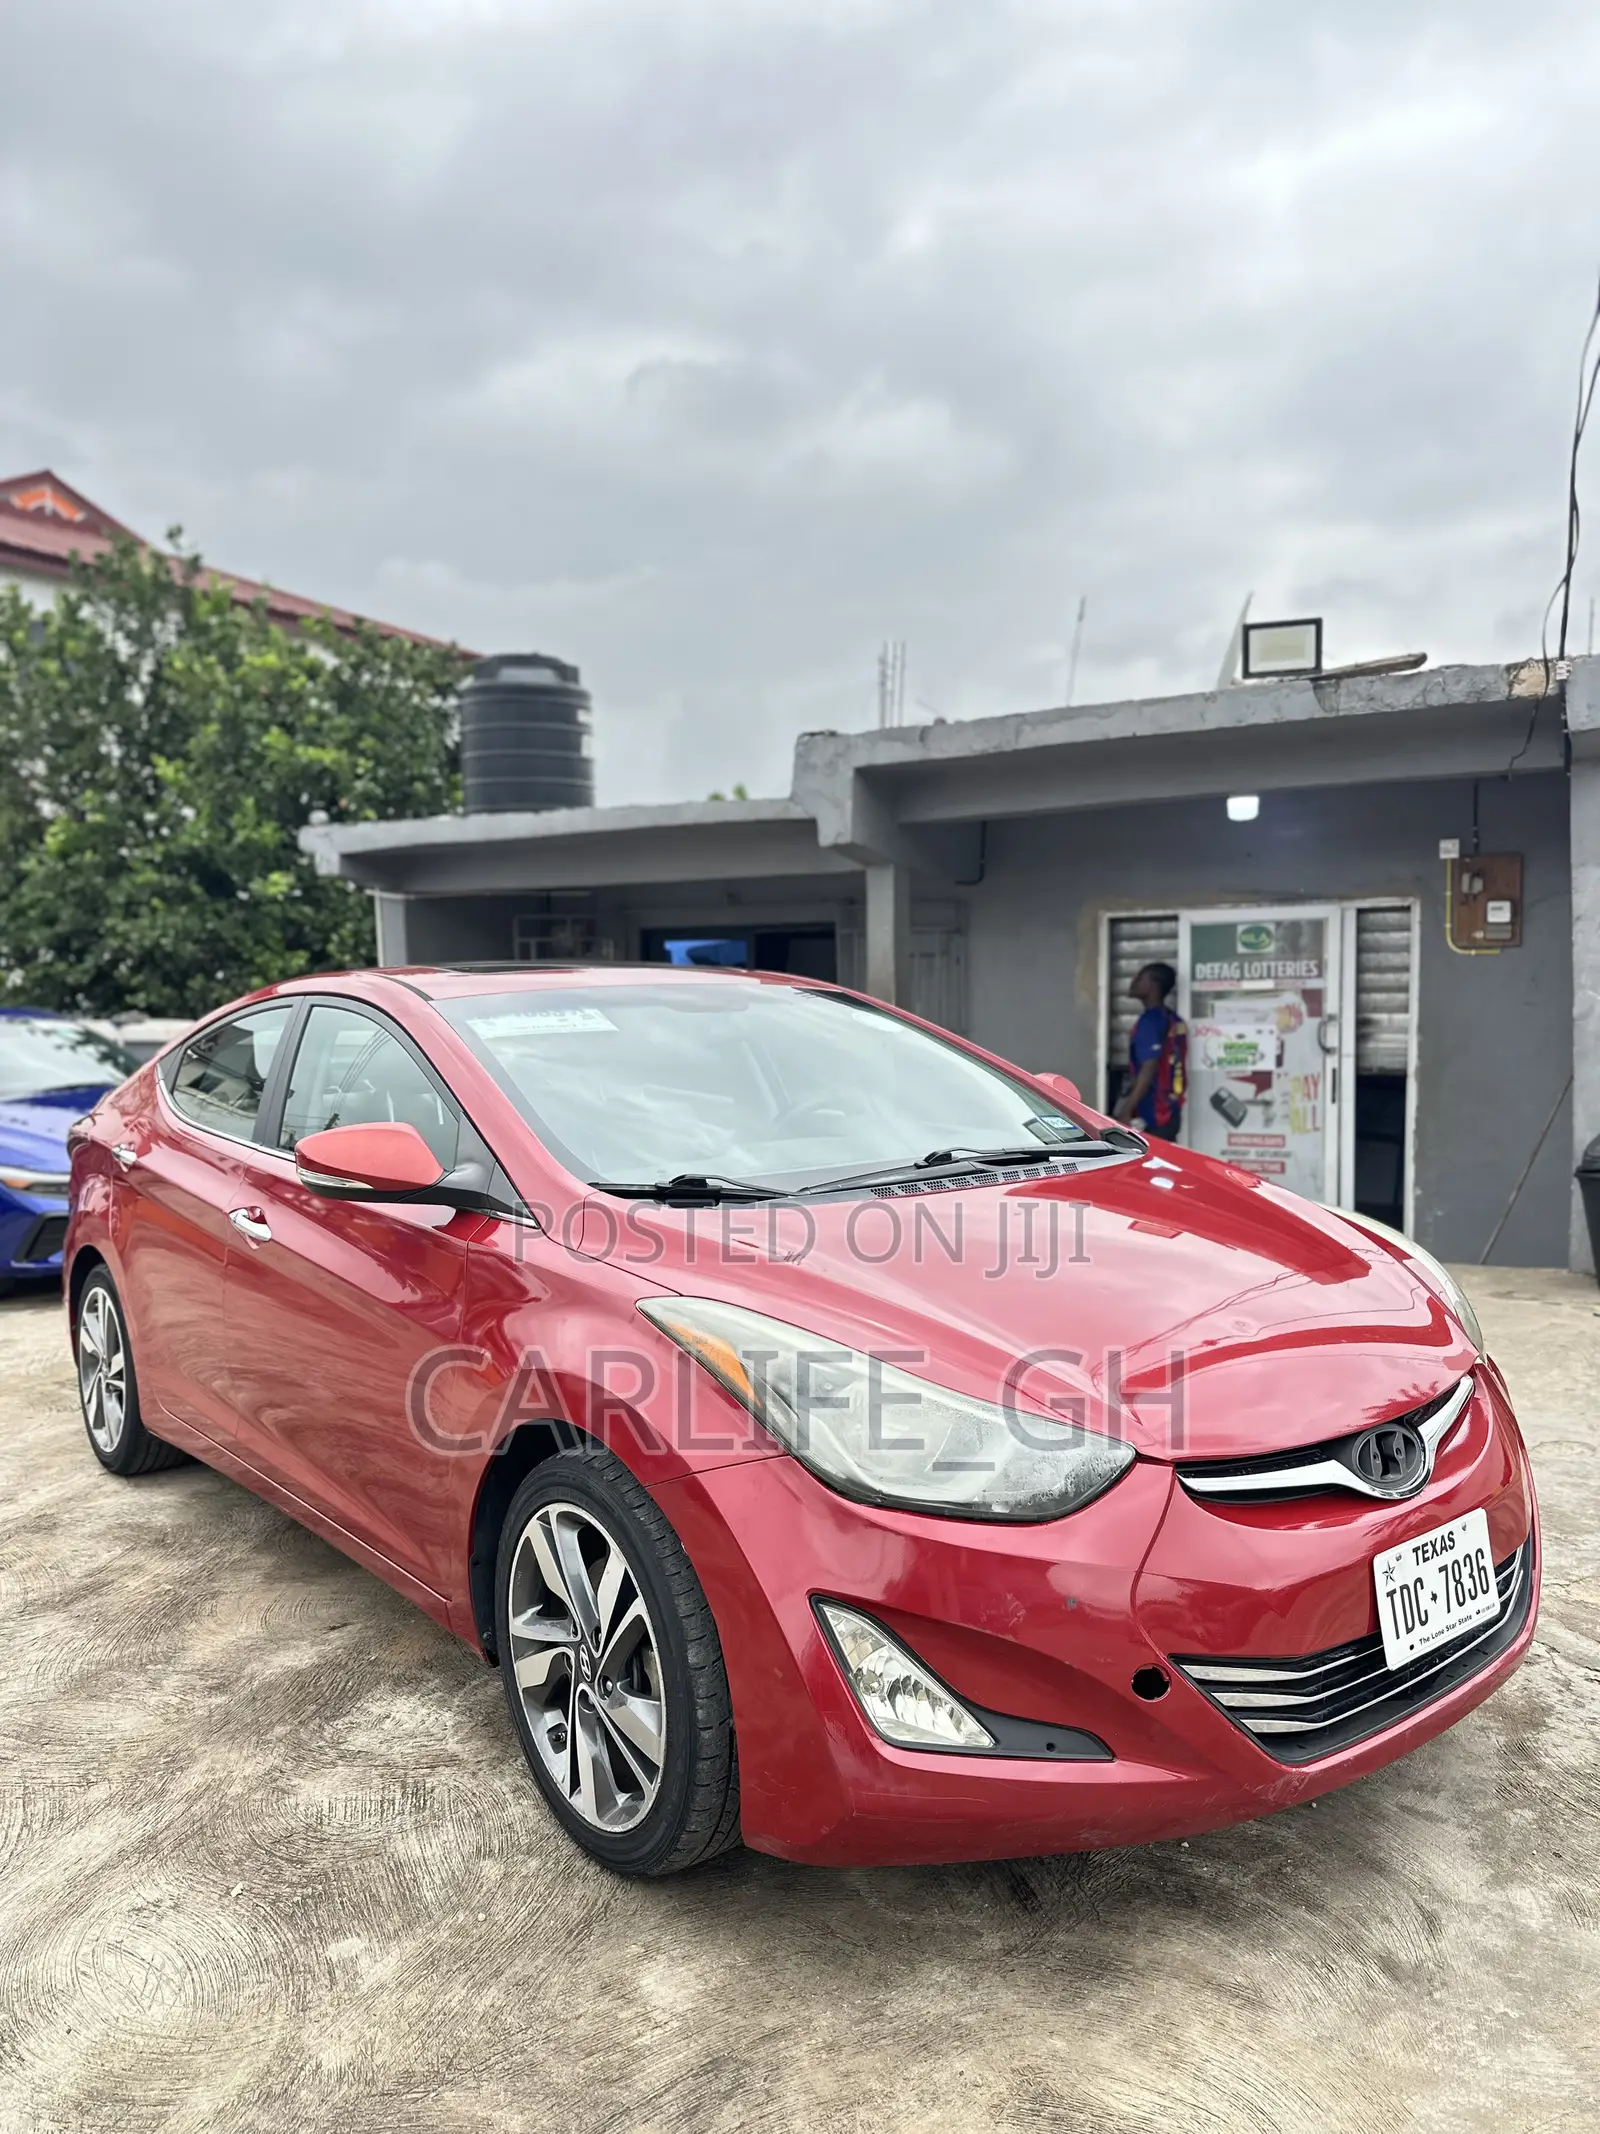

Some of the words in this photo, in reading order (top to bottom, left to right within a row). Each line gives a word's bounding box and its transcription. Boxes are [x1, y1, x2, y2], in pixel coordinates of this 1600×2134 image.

[1195, 962, 1240, 980] DEFAG
[1244, 960, 1319, 978] LOTTERIES
[1412, 1530, 1456, 1566] TEXAS
[1386, 1577, 1429, 1640] TDC
[1438, 1547, 1490, 1614] 7836
[1419, 1636, 1430, 1645] The
[1431, 1629, 1445, 1640] Lone
[1445, 1622, 1457, 1632] Star
[1458, 1614, 1473, 1626] State
